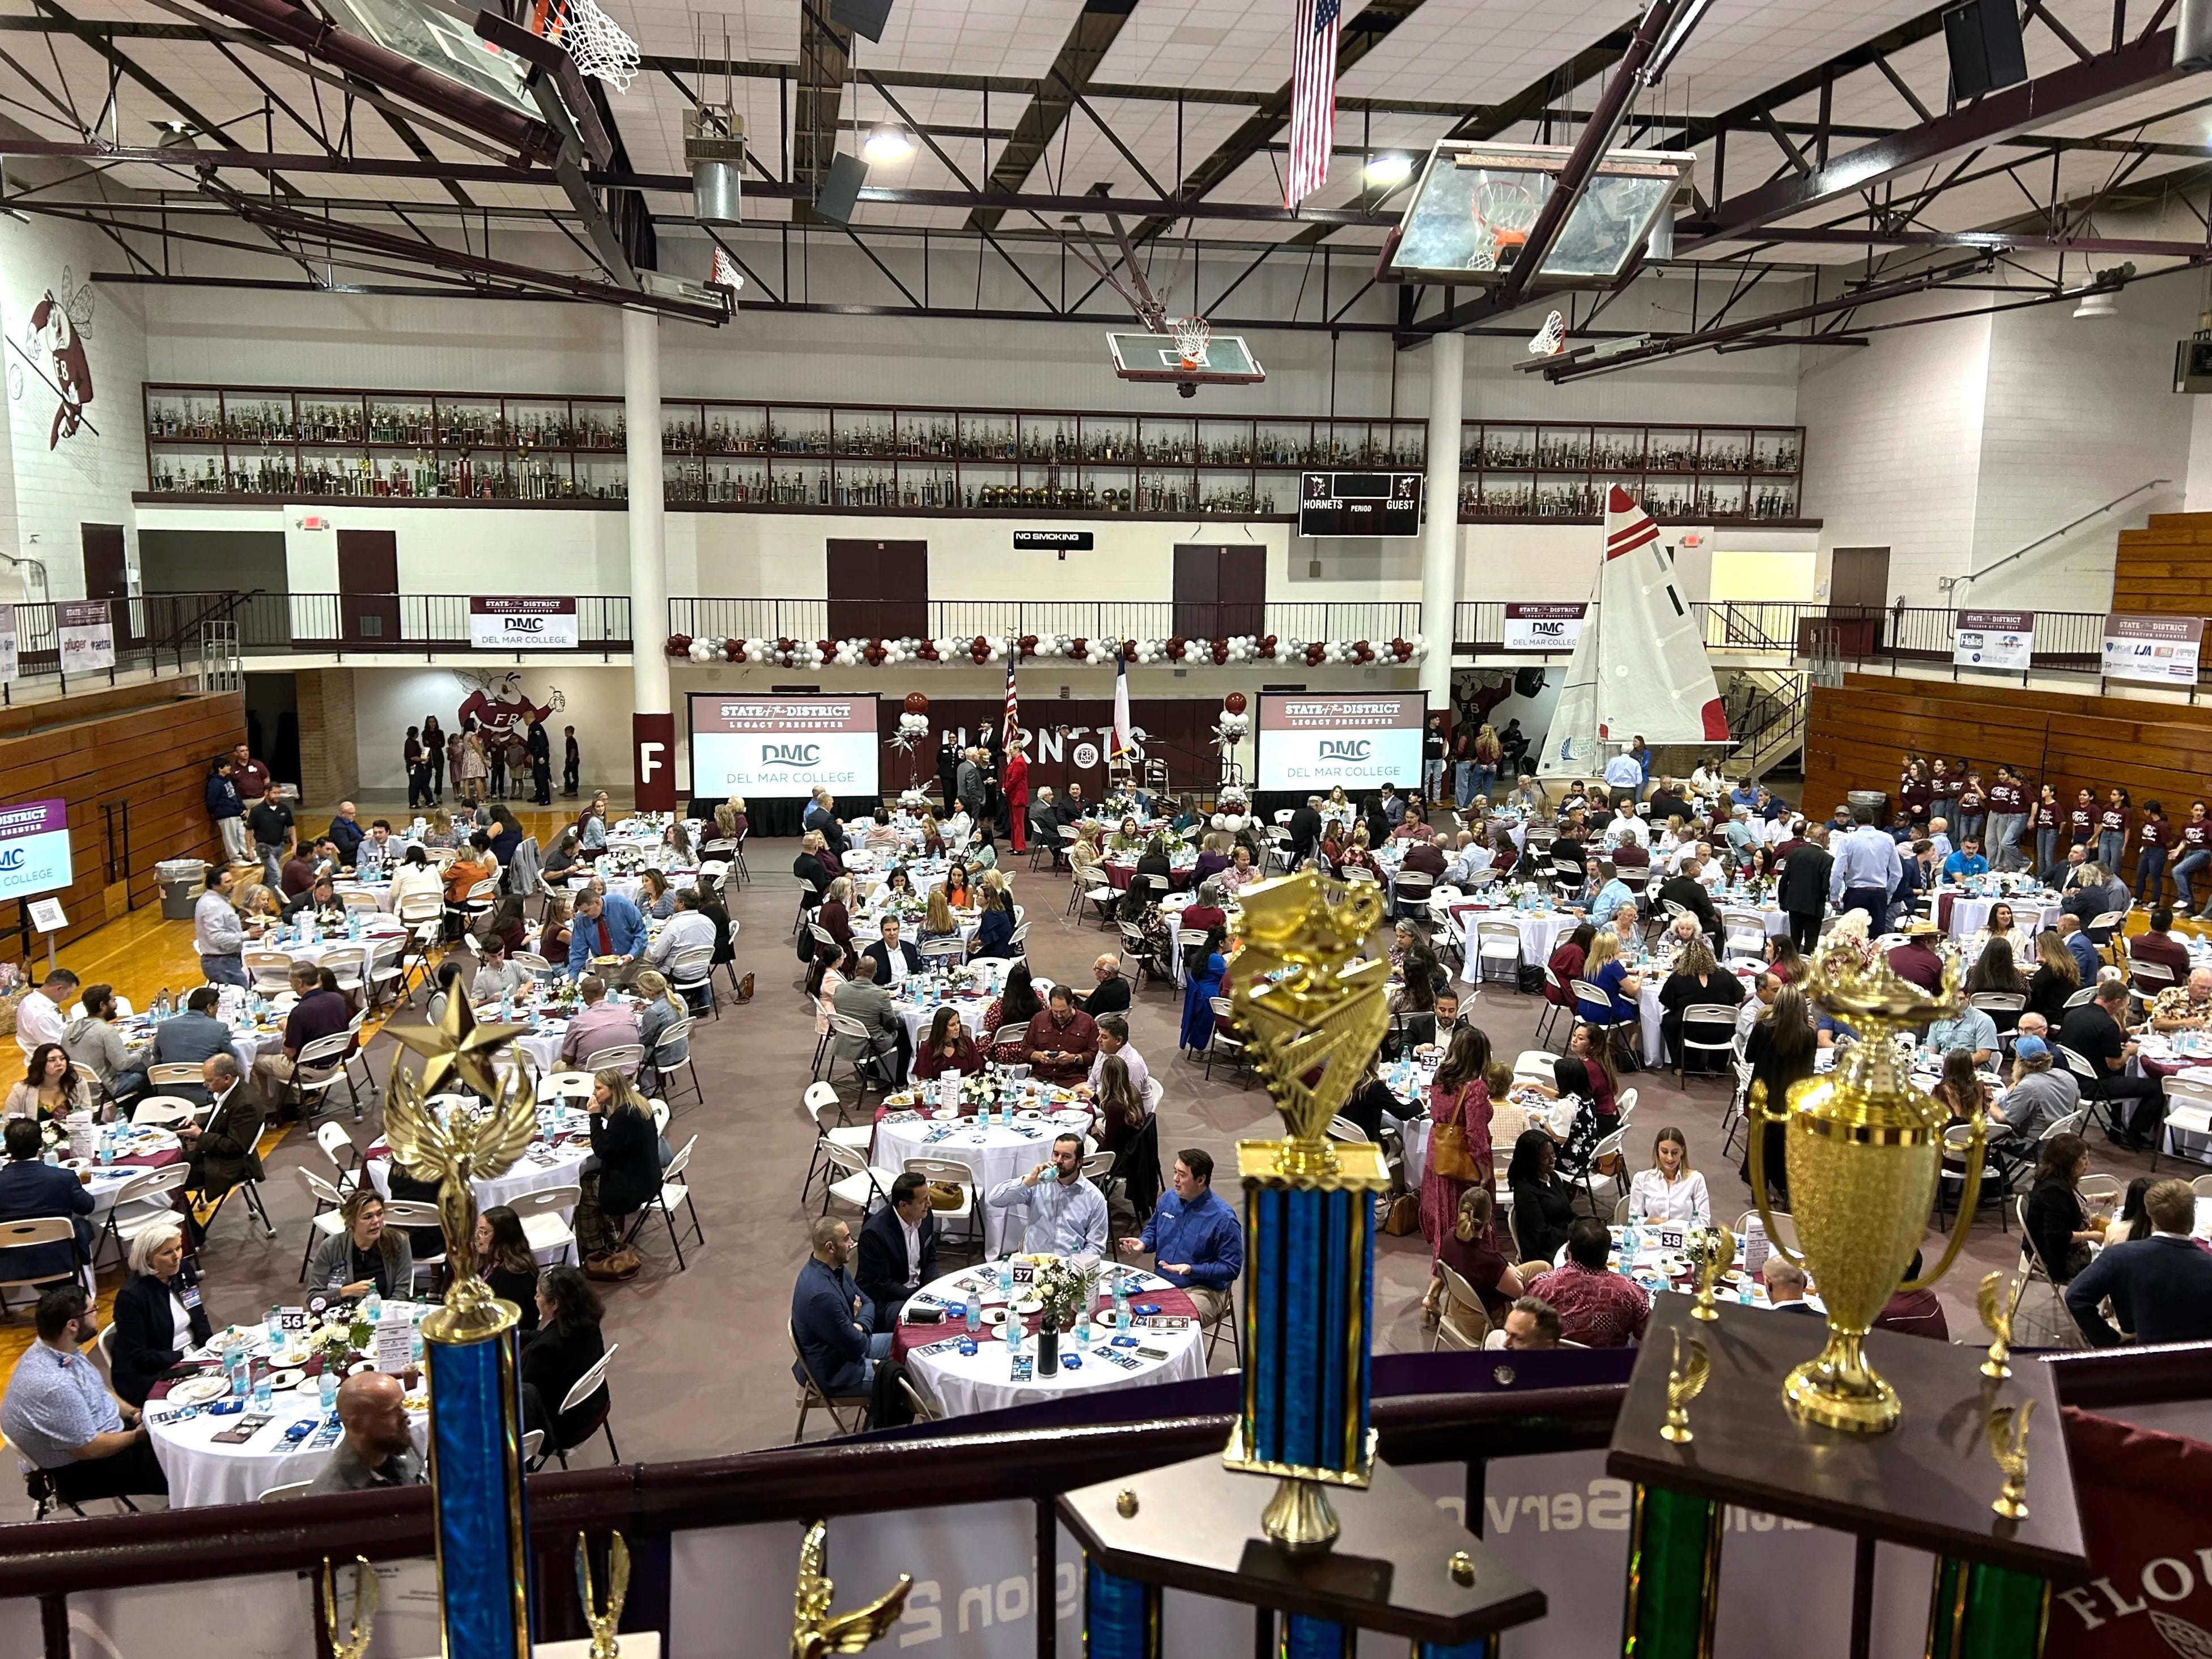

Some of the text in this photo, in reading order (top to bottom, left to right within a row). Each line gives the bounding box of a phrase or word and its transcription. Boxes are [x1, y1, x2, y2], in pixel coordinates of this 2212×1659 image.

[1304, 499, 1415, 510] HORNETS GUEST
[504, 618, 544, 629] DMC
[1532, 622, 1564, 633] DMC
[64, 638, 111, 652] pfluger aetna
[1961, 635, 1982, 646] Hellas
[2134, 645, 2151, 656] LJA
[721, 706, 763, 716] STATE
[787, 706, 851, 716] DISTRICT
[1285, 705, 1322, 714] STATE
[1343, 704, 1400, 714] DISTRICT
[1461, 703, 1480, 714] FB
[494, 713, 519, 725] FB
[942, 726, 1146, 764] RNTS
[1319, 740, 1371, 757] DMC
[762, 744, 820, 762] DMC
[640, 742, 665, 783] F
[1288, 766, 1400, 777] DEL MAR COLLEGE
[727, 772, 855, 783] DEL MAR COLLEGE
[0, 824, 41, 837] ESENTER
[0, 848, 24, 865] MC
[4, 868, 53, 886] COLLEGE
[1663, 1235, 1680, 1246] 38
[1014, 1270, 1032, 1281] 37
[283, 1316, 302, 1328] 36
